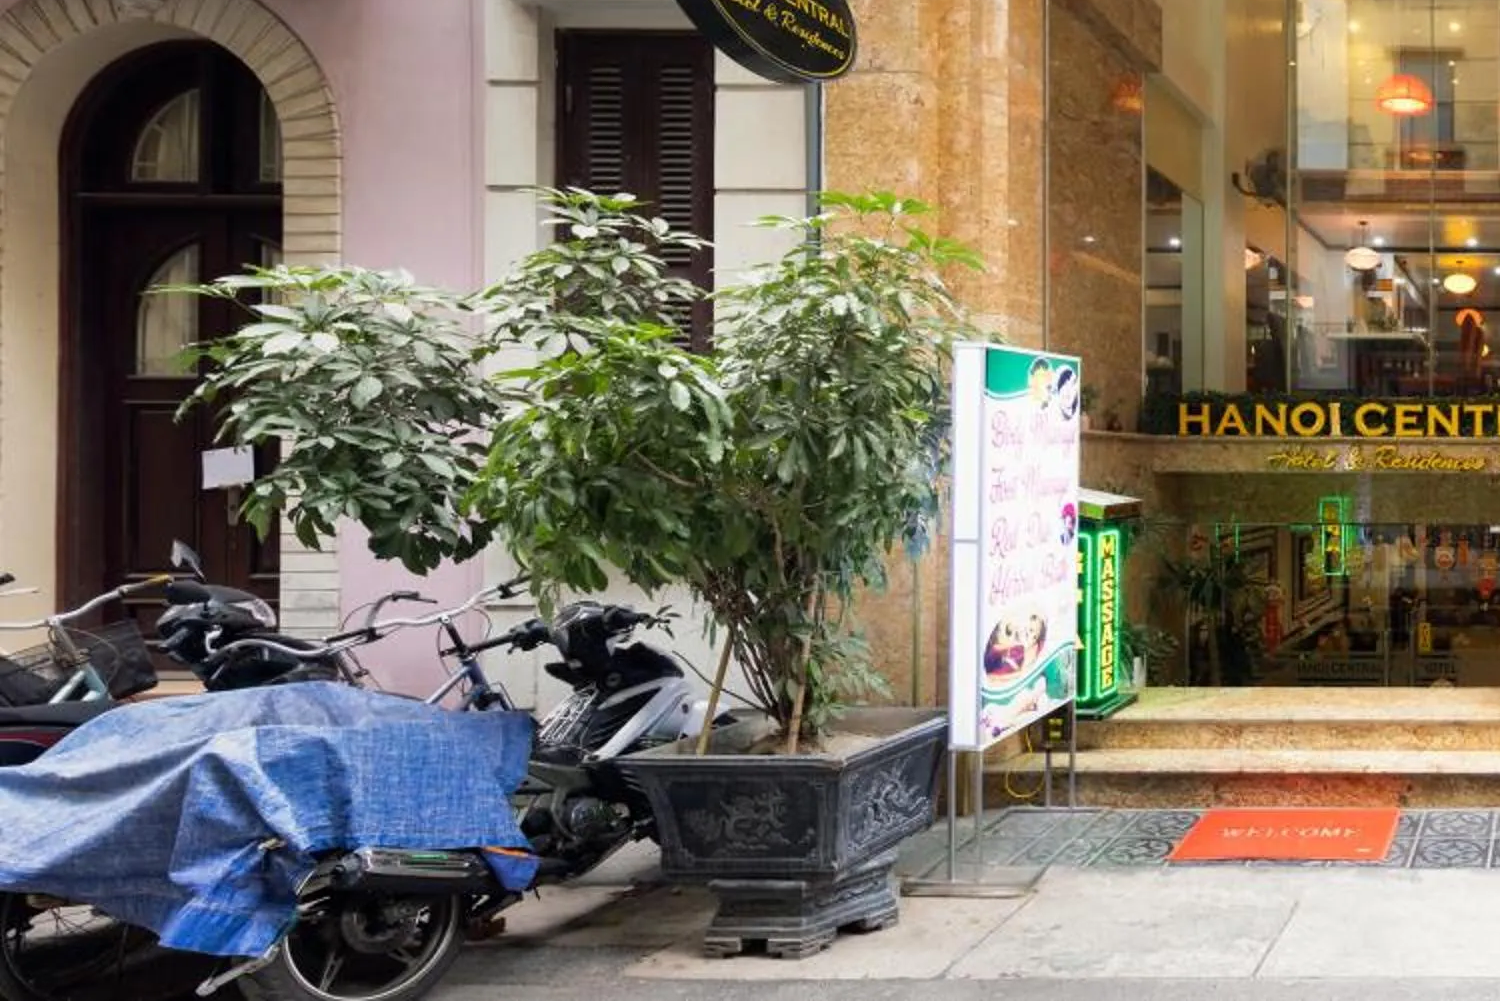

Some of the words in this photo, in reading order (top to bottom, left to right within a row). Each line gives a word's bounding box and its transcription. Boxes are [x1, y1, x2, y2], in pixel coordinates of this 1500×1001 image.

[1177, 402, 1341, 437] HANOI
[1101, 534, 1115, 690] MASSAGE
[1219, 826, 1362, 840] WELCOME
